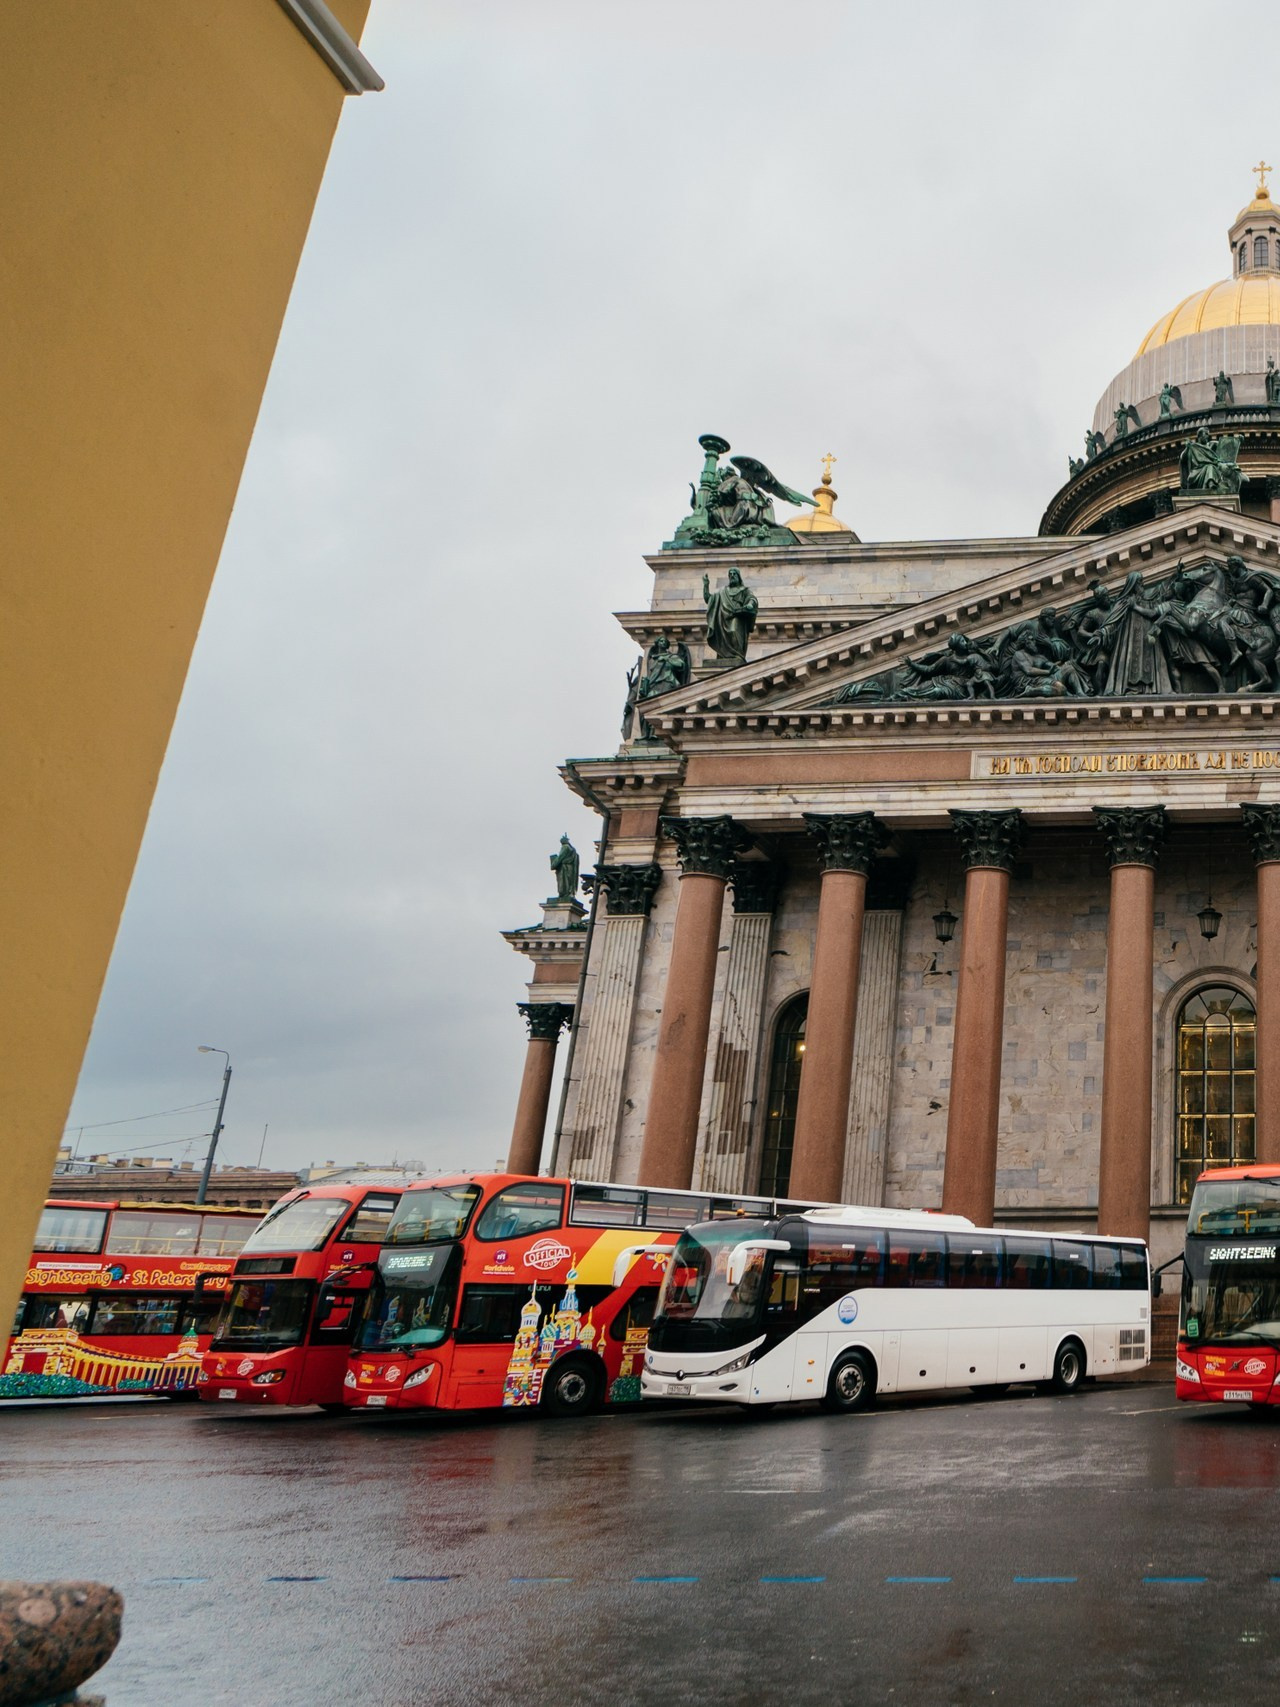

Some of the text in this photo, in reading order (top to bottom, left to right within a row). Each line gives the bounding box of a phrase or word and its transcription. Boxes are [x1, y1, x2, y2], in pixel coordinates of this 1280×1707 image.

[528, 1248, 568, 1262] OFFICIAL
[1209, 1246, 1277, 1260] SIGHTSEEING
[25, 1268, 113, 1286] Sightseeing
[132, 1269, 149, 1286] St
